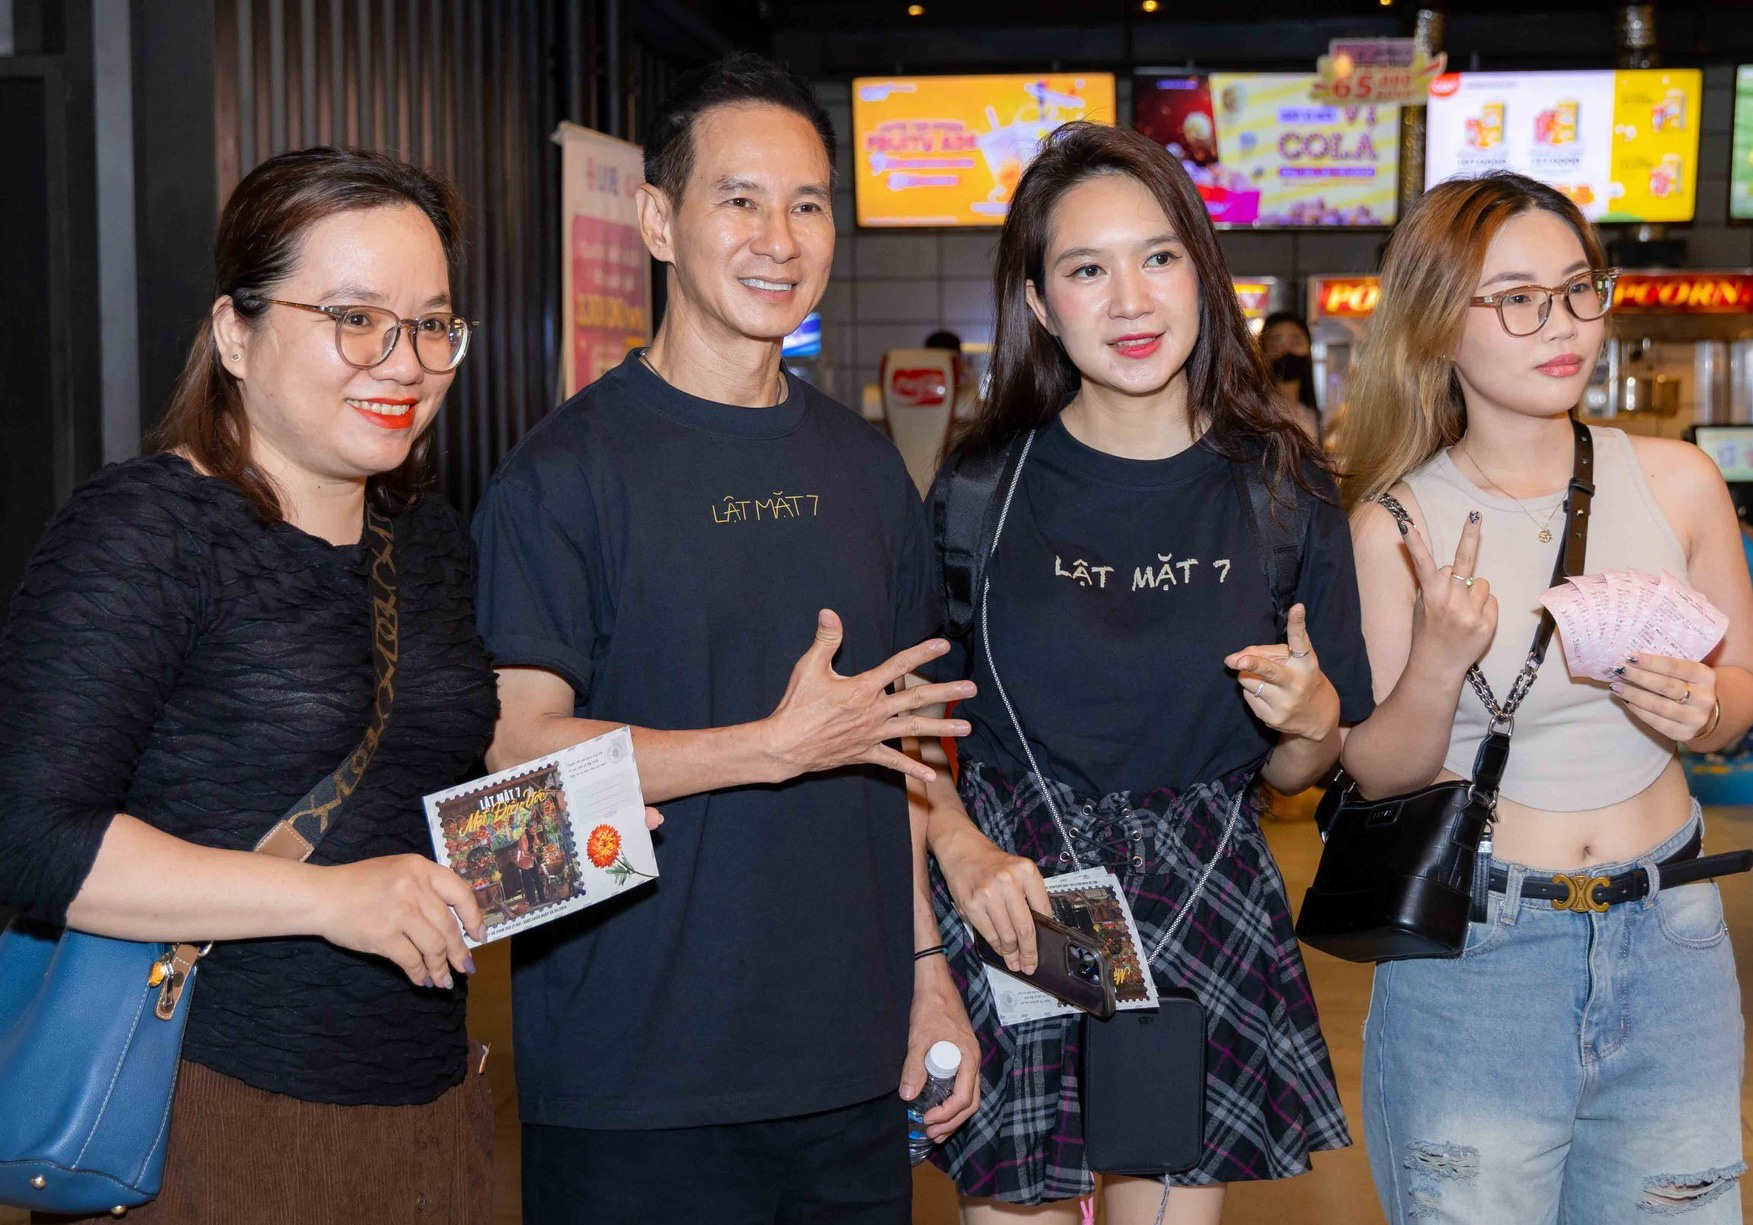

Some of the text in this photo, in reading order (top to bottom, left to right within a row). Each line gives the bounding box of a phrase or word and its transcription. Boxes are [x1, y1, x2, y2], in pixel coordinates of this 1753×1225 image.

[1278, 132, 1377, 160] COLA
[712, 491, 819, 523] LẬT MẶT 7
[1056, 553, 1231, 592] LẬT MẶT 7
